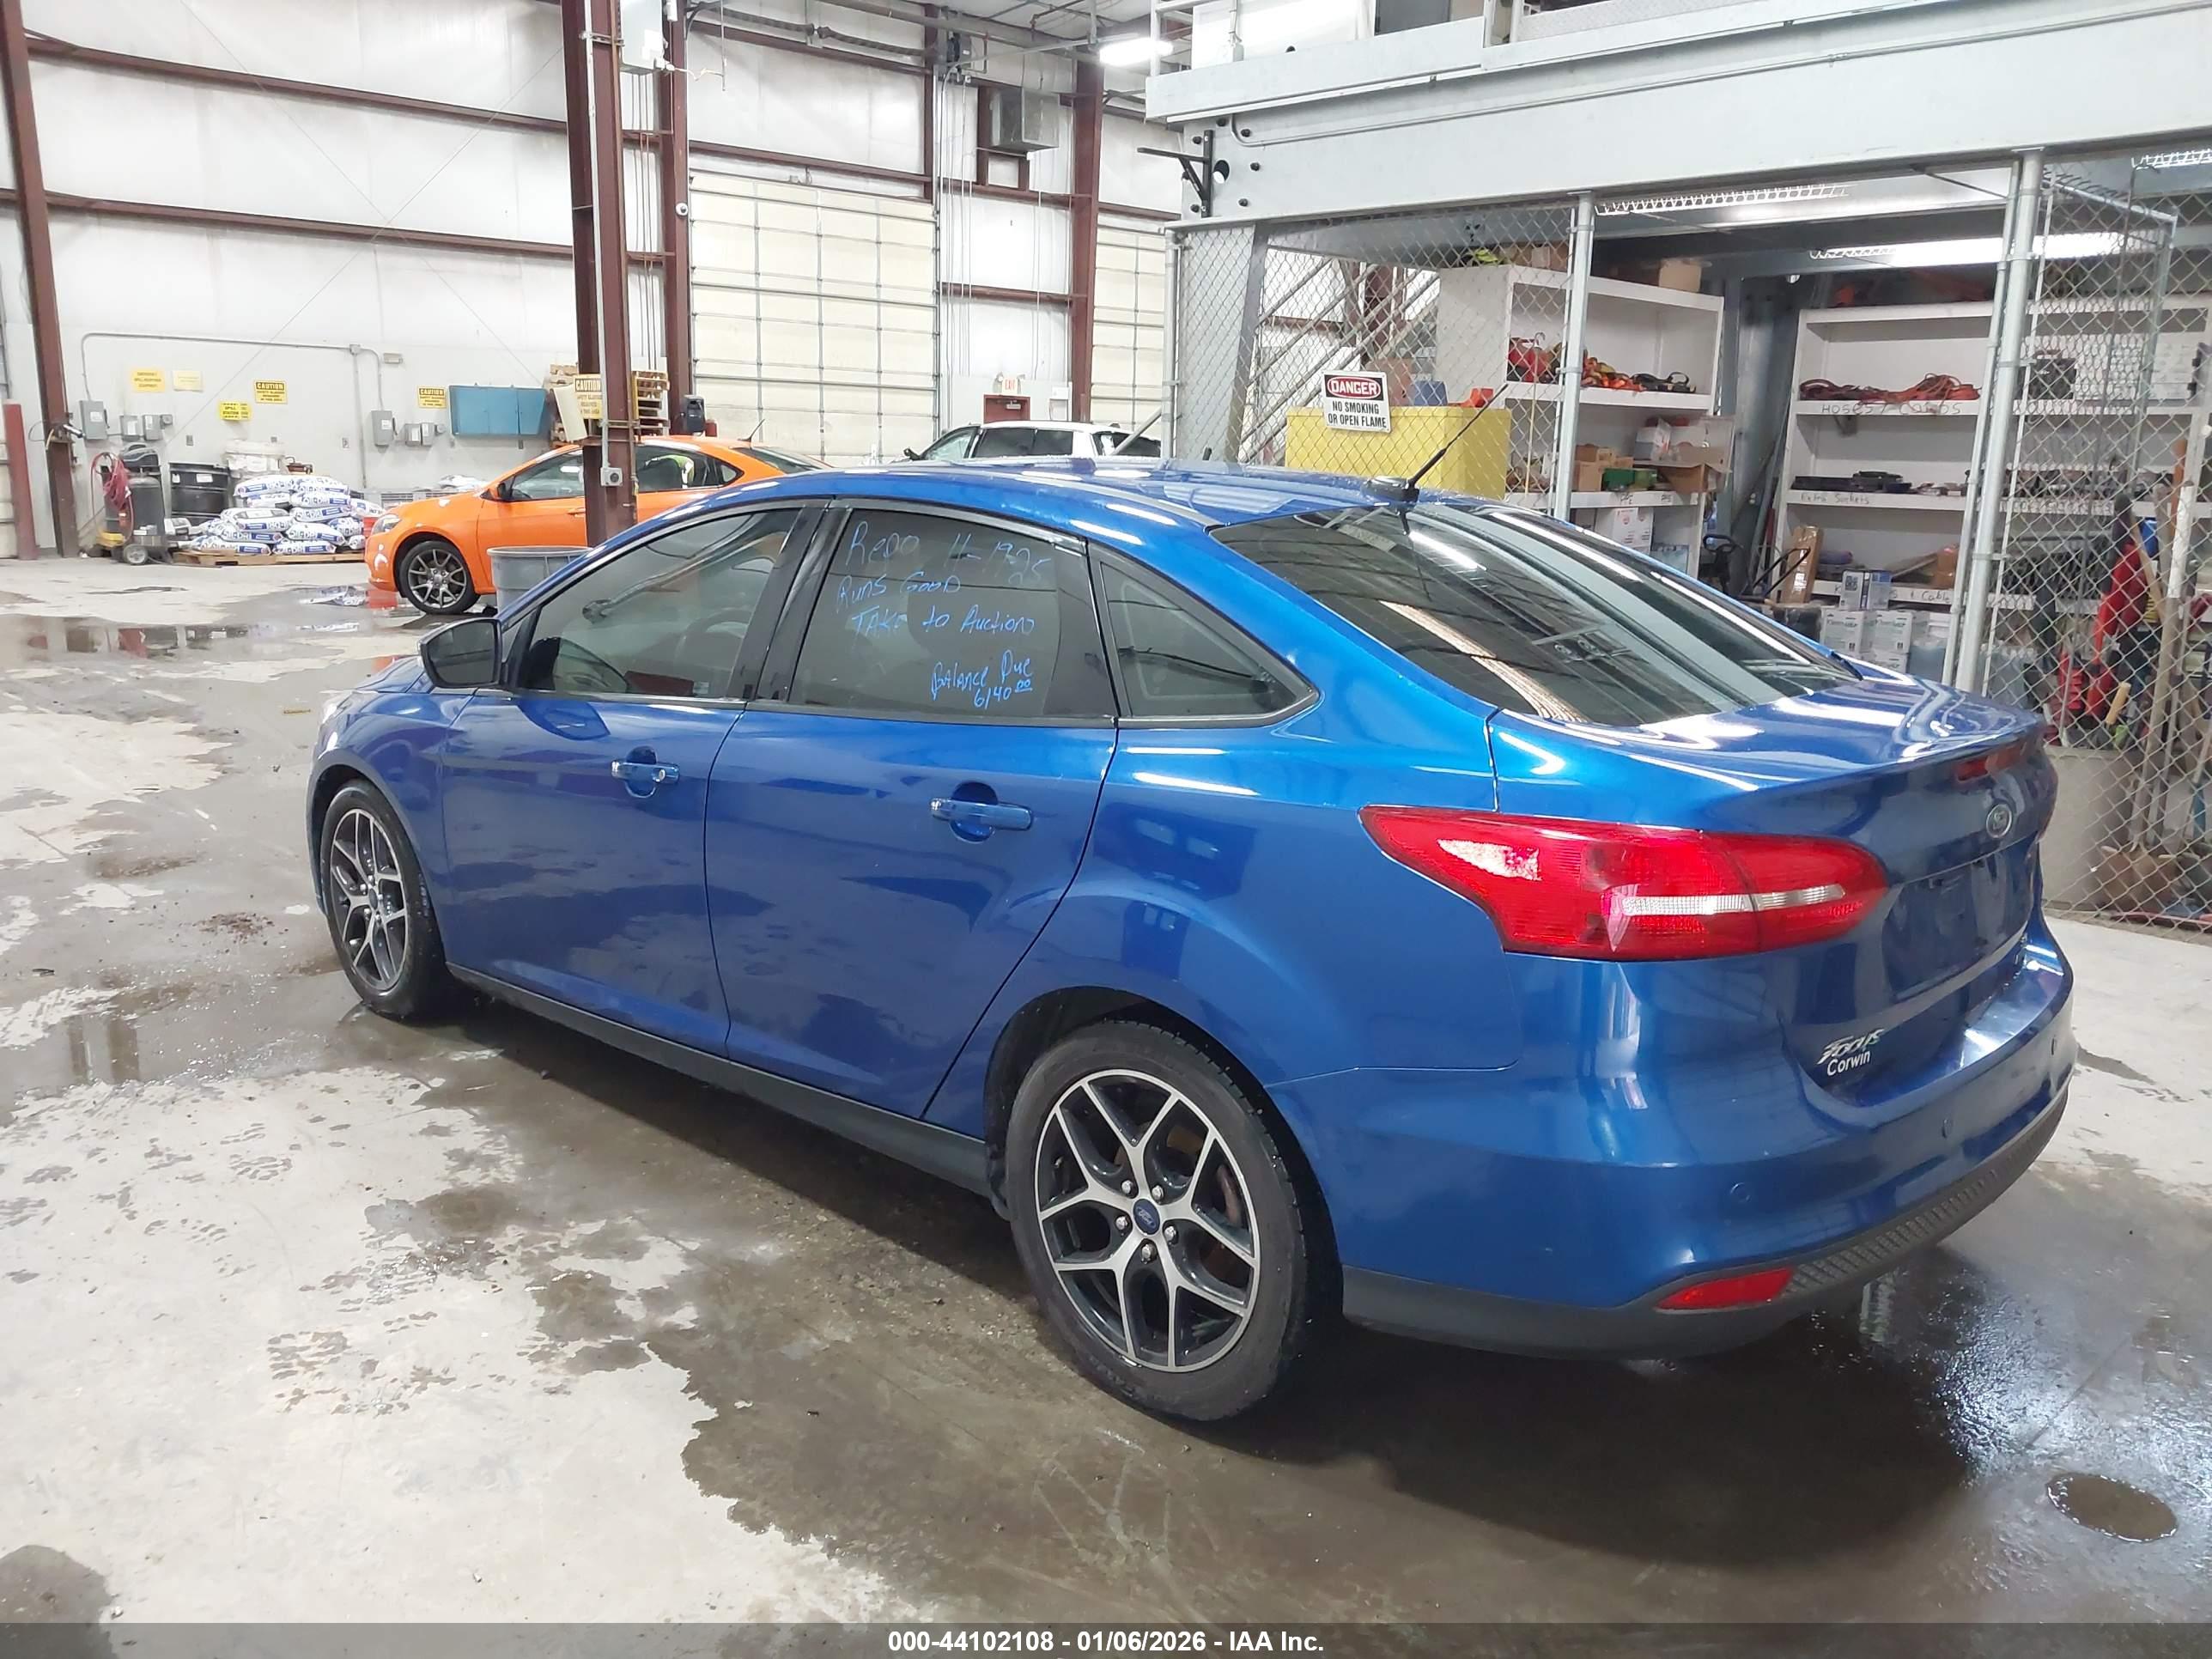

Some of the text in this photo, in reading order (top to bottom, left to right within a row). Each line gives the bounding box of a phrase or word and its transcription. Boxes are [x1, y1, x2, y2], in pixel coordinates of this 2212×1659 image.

[576, 380, 601, 392] CAUTION
[1330, 380, 1377, 395] DANGER
[1332, 400, 1379, 415] NO SMOKING
[1328, 413, 1387, 428] OR OPEN FLAME
[921, 604, 950, 633] to
[1826, 1050, 1870, 1076] Corwin
